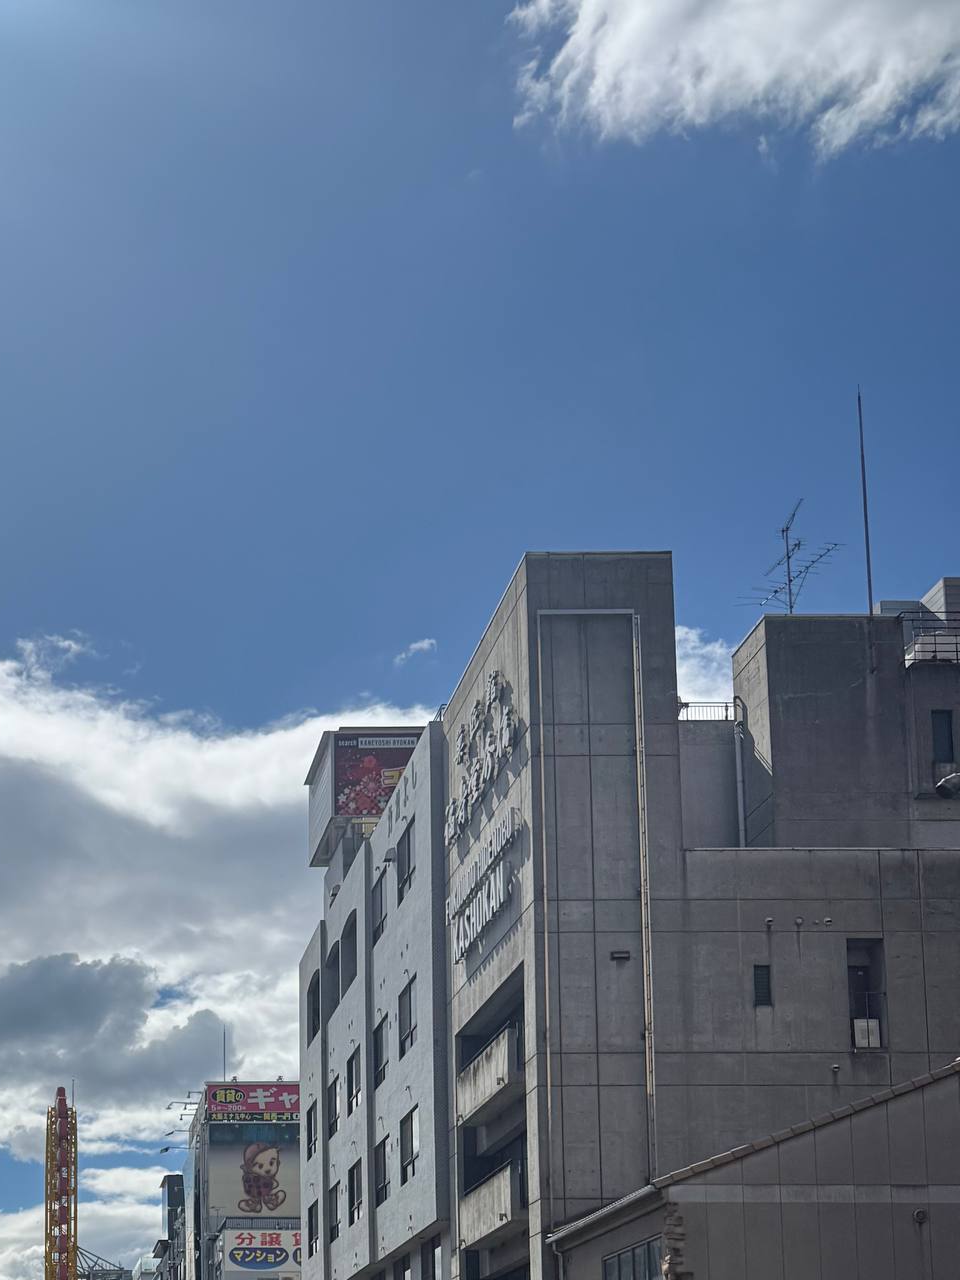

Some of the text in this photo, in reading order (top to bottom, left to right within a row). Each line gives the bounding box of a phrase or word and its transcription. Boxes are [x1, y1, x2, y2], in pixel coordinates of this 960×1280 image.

[454, 861, 504, 964] KASHOKAN
[233, 1250, 286, 1262] マンション
